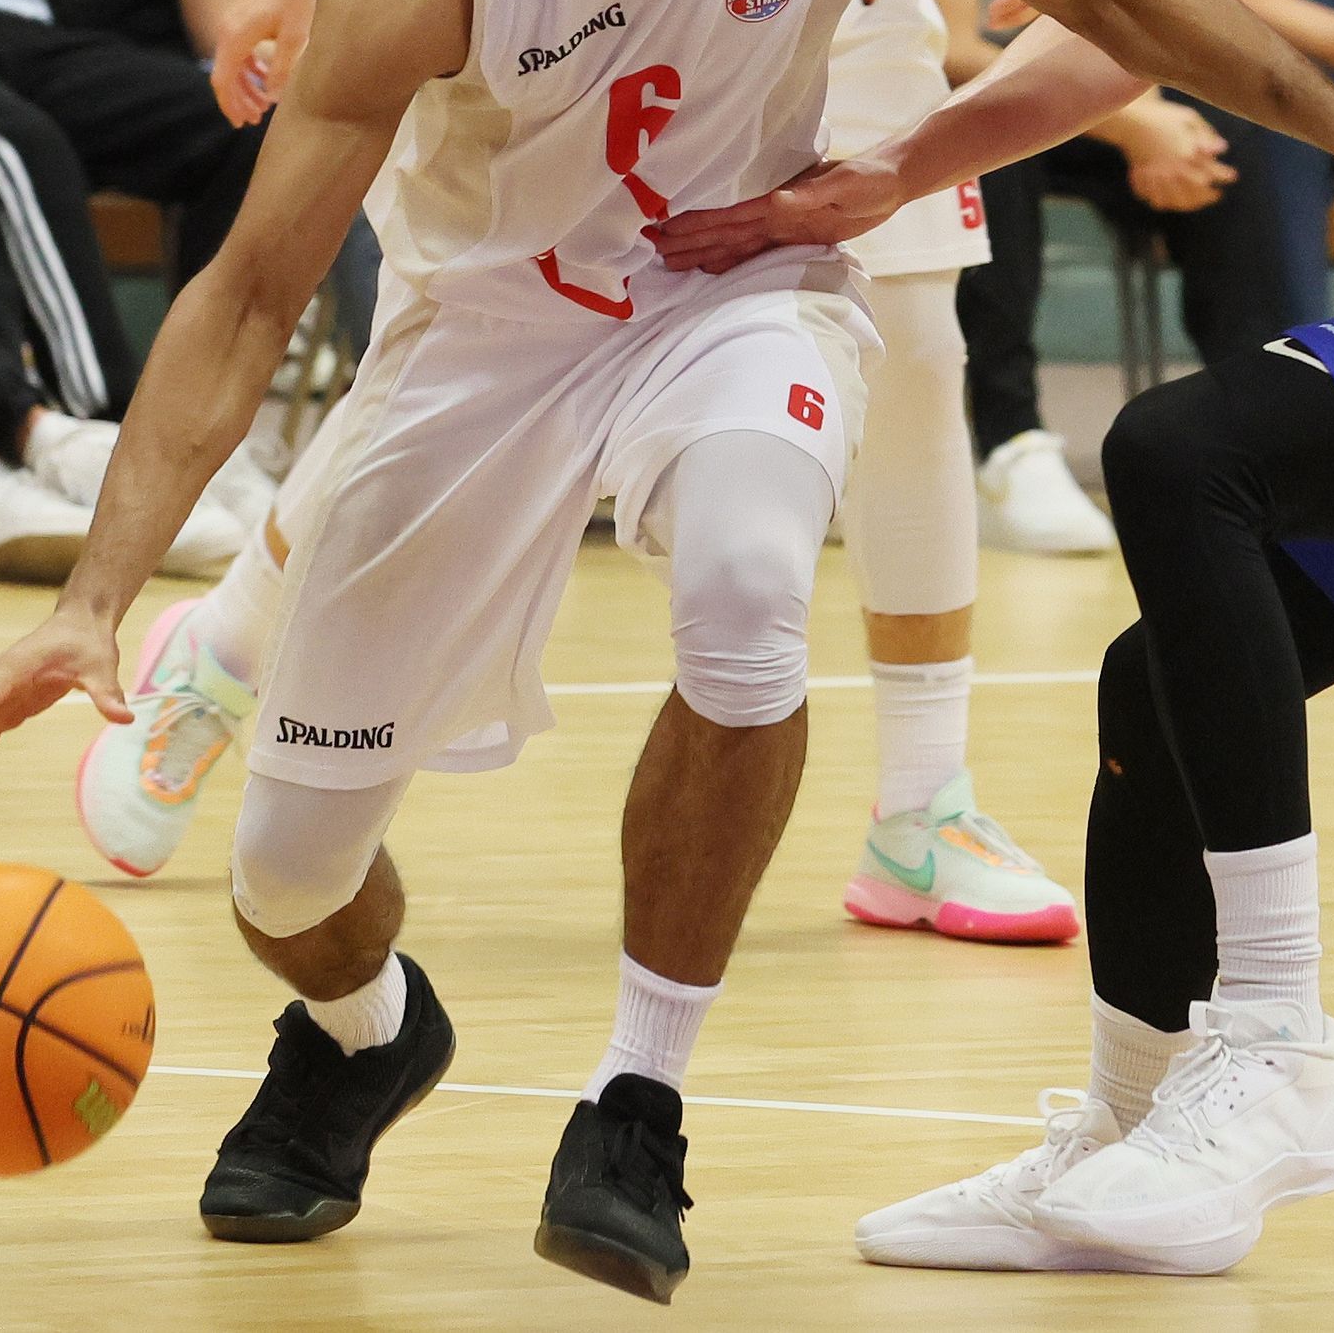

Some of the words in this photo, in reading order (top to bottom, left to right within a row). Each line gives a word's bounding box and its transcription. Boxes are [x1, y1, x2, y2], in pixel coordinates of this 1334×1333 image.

[517, 2, 627, 77] SPALDING
[956, 179, 984, 229] 5
[787, 383, 826, 431] 6
[276, 716, 395, 750] SPALDING
